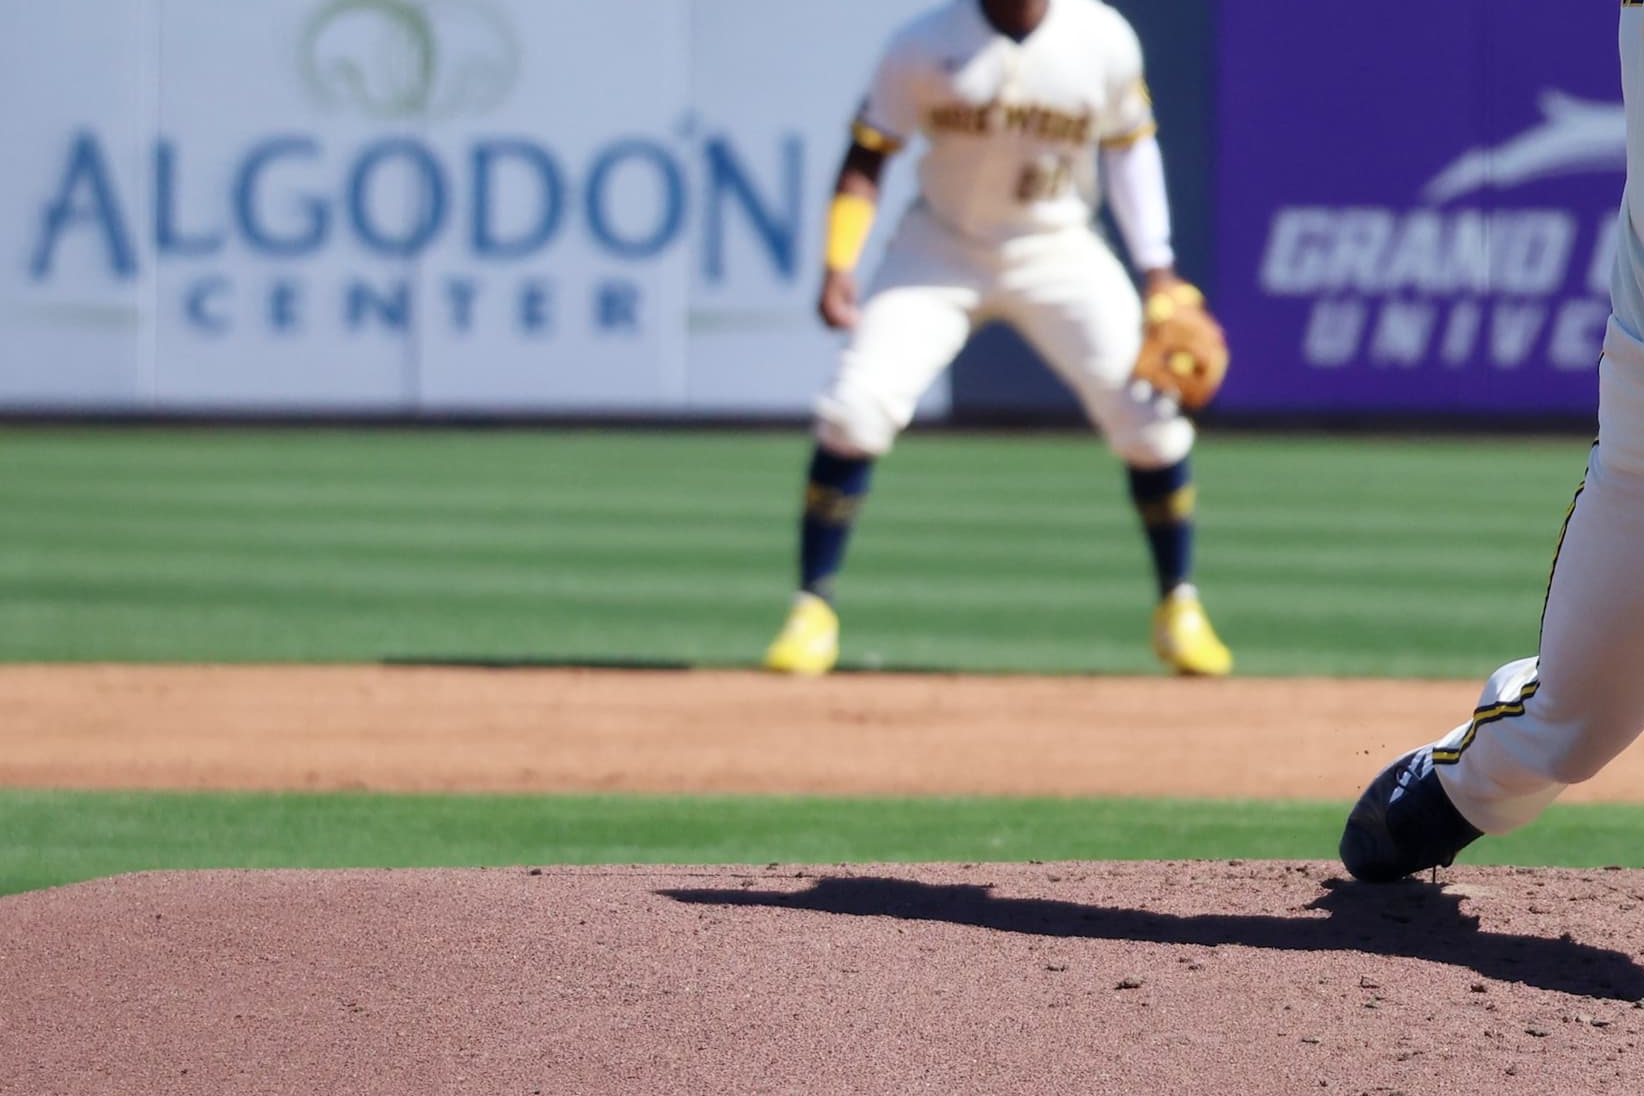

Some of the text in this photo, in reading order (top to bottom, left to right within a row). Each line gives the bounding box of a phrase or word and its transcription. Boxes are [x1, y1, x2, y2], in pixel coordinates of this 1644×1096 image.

[1261, 207, 1576, 297] GRAND
[184, 274, 648, 338] CENTER
[1305, 298, 1612, 371] UNIVE
